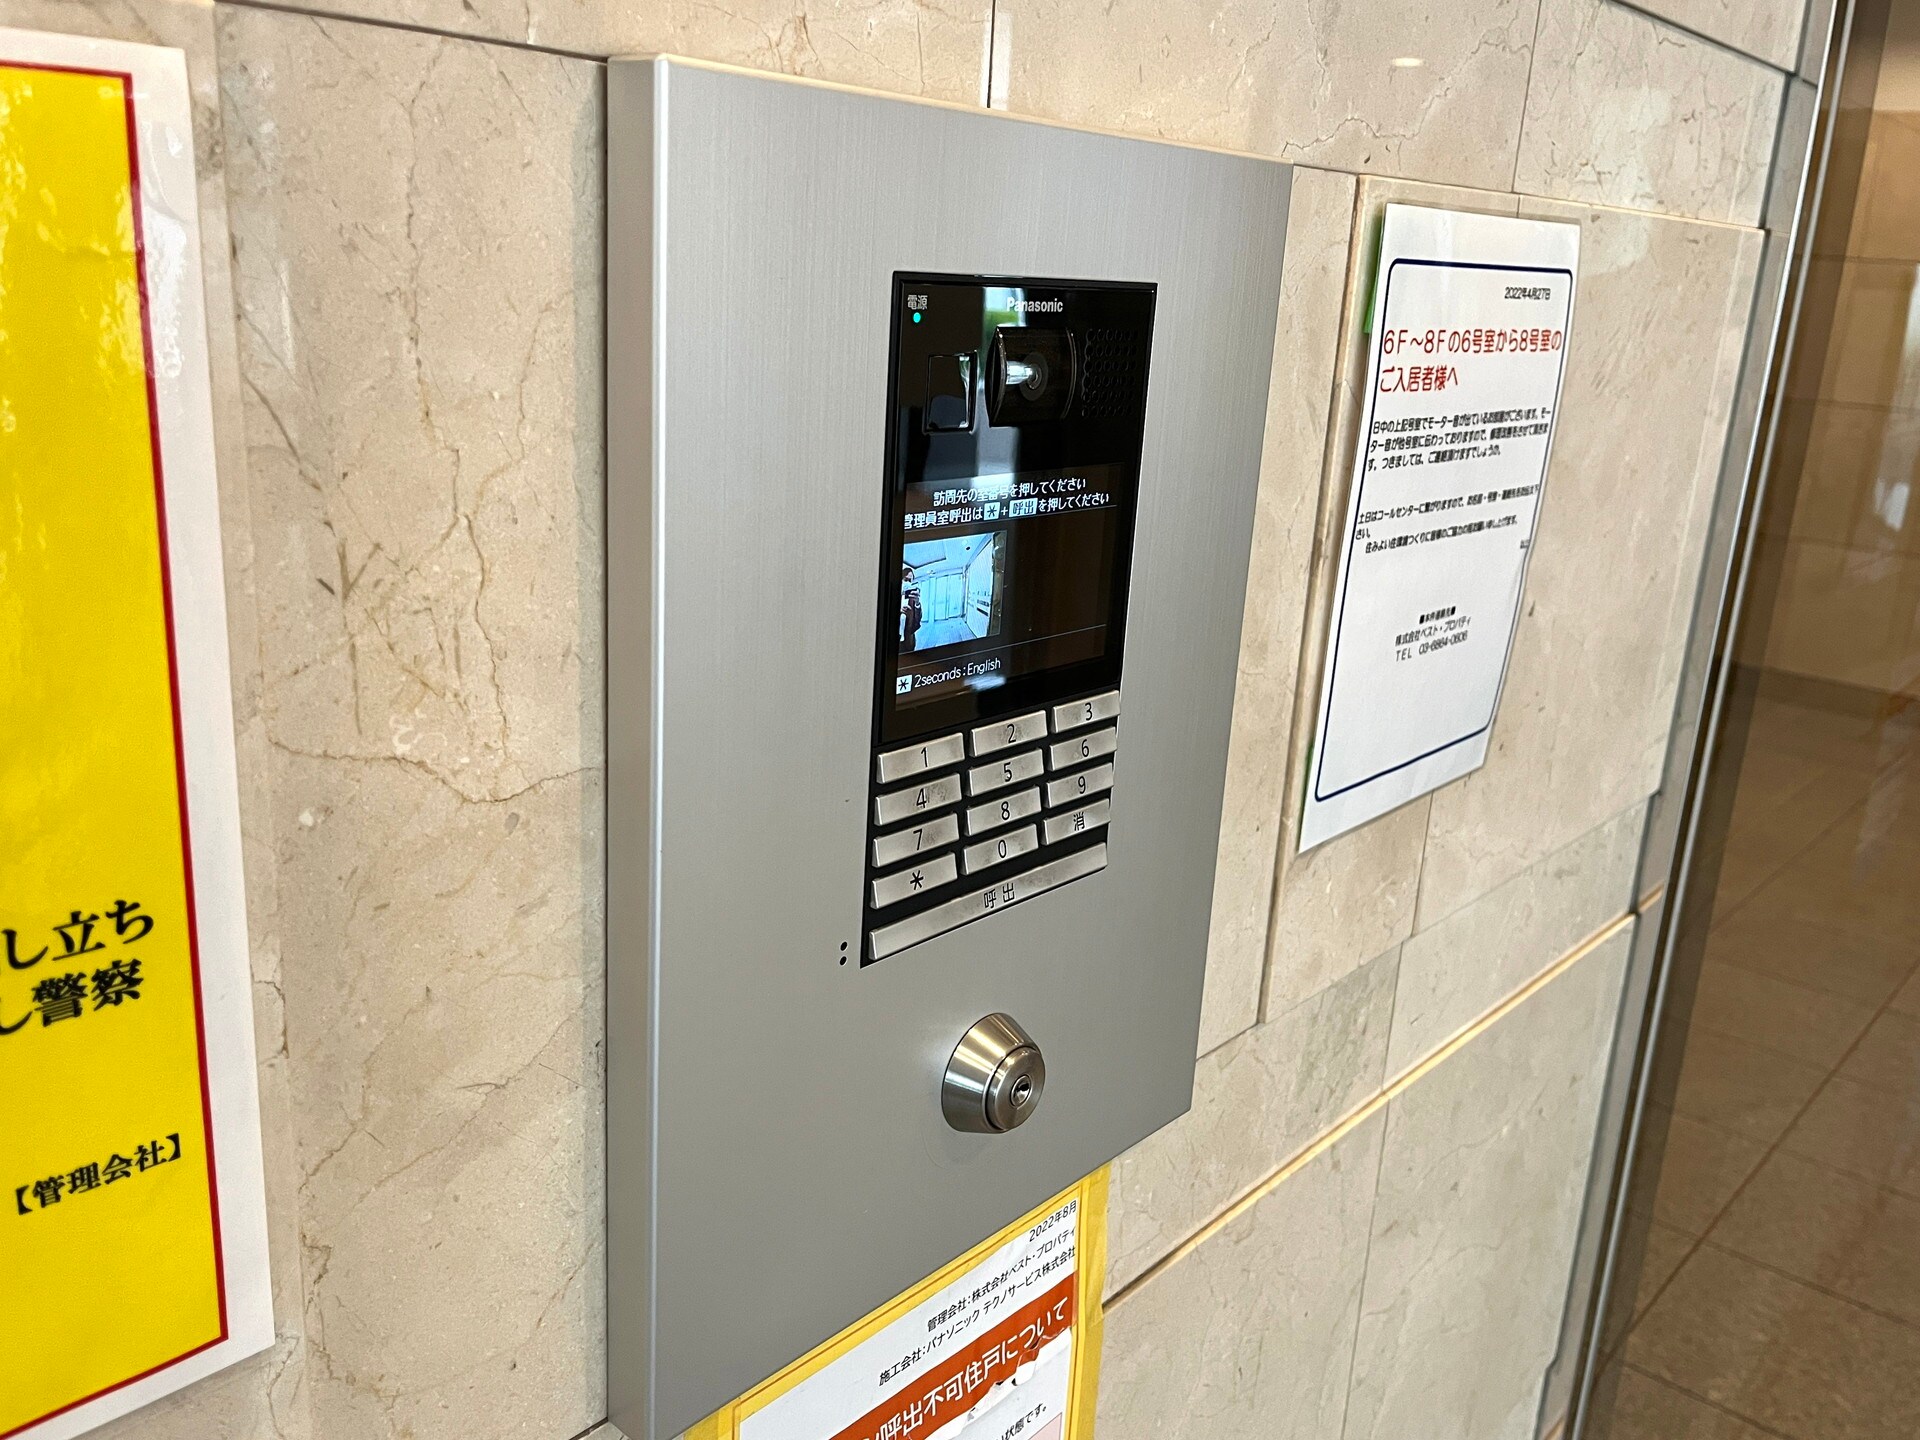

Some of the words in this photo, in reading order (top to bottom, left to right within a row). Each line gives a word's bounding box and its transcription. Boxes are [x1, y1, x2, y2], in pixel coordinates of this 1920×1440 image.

[907, 294, 928, 310] 電源
[1504, 286, 1551, 301] 2022年4月27日
[1006, 297, 1064, 313] Panasonic
[1380, 364, 1459, 393] ご入居者様へ
[933, 478, 1086, 507] 訪問先の室番号を押してください
[967, 658, 1001, 679] English
[1085, 702, 1093, 721] 3
[1007, 724, 1016, 743] 2
[920, 747, 928, 768] 1
[1081, 739, 1090, 757] 6
[1003, 762, 1013, 782] 5
[1077, 776, 1086, 794] 9
[916, 790, 927, 809] 4
[1001, 801, 1011, 820] 8
[1073, 811, 1086, 831] 消
[913, 829, 923, 851] 7
[998, 840, 1007, 858] 0
[983, 882, 1015, 909] 呼出
[0, 899, 155, 970] し立ち
[1028, 1200, 1077, 1242] 2022年8月
